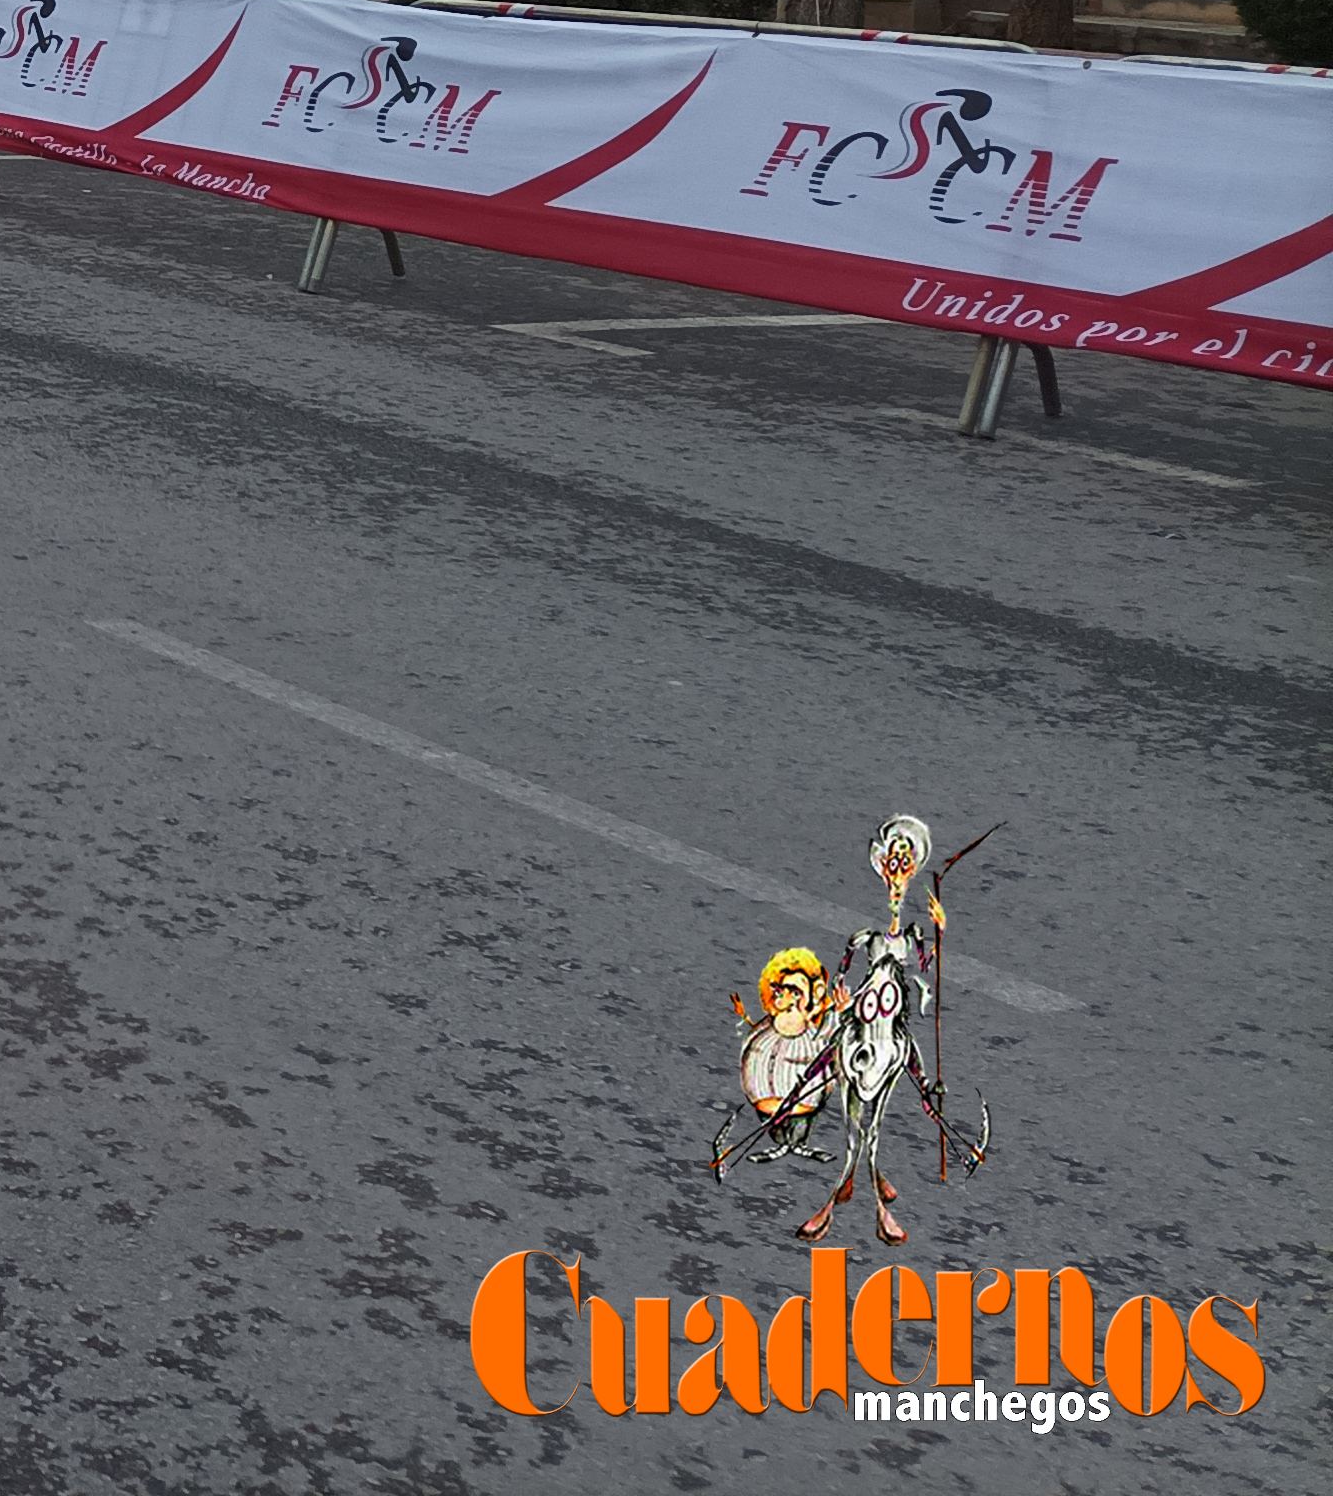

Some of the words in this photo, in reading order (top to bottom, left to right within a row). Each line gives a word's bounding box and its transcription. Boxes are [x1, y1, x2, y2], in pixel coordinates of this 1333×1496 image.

[172, 161, 271, 201] Mancha
[902, 277, 1070, 332] Unidos
[1076, 319, 1179, 348] por
[1192, 328, 1248, 359] el
